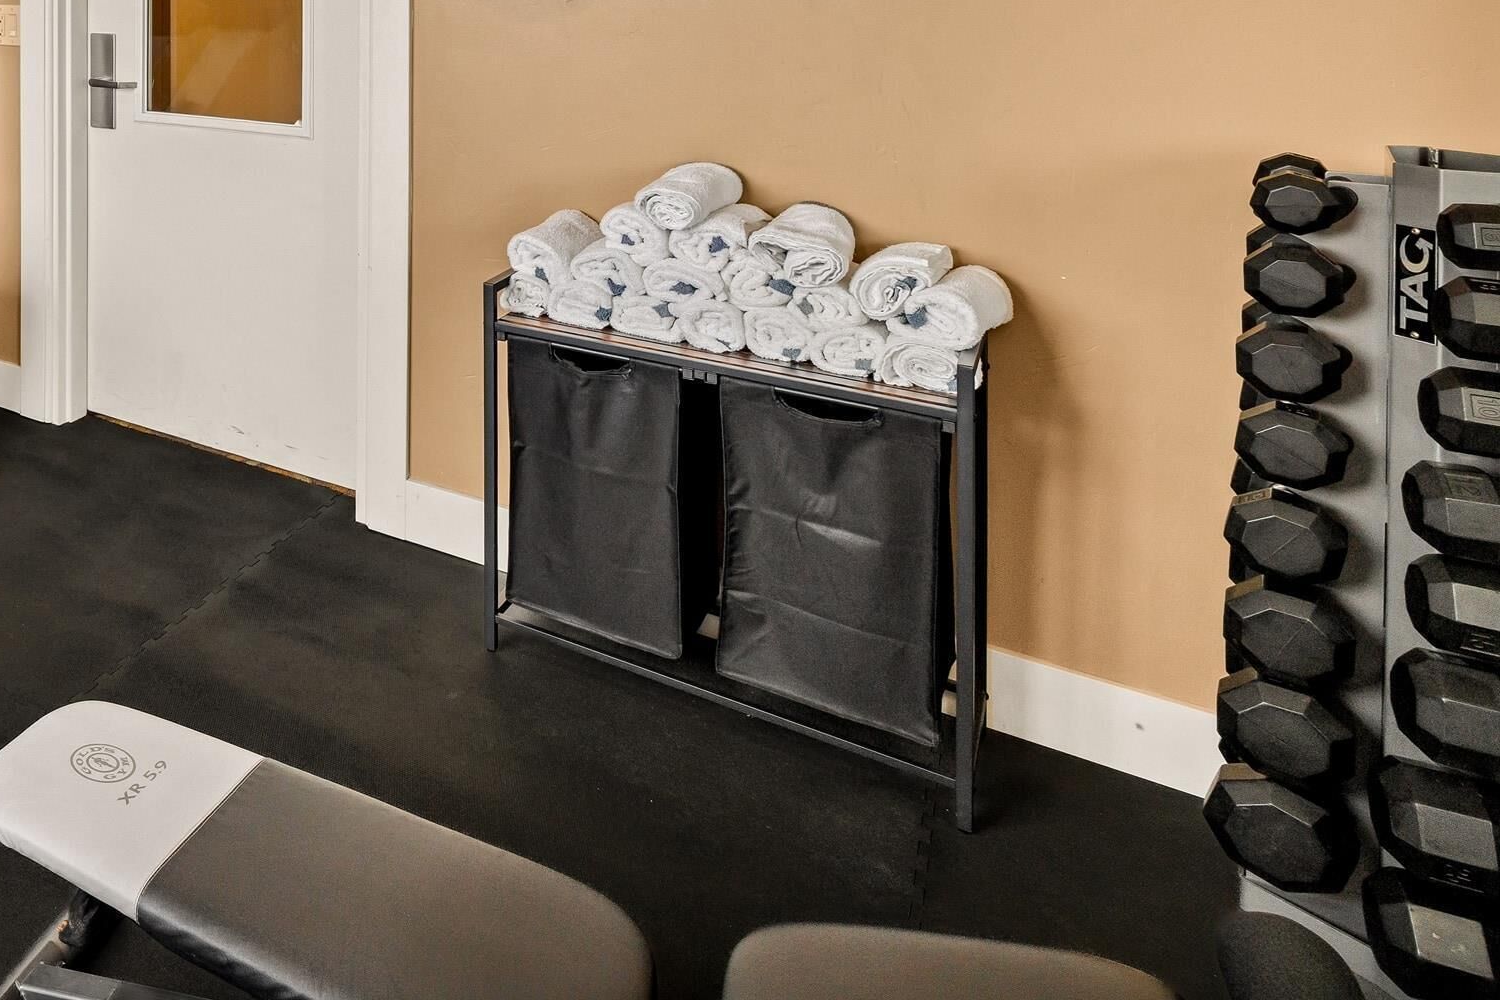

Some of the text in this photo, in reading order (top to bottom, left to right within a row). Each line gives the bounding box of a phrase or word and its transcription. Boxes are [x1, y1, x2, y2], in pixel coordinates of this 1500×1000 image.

[1399, 234, 1434, 331] TAG
[75, 746, 131, 780] GOLD'S GYM
[116, 760, 167, 806] XR 5.9
